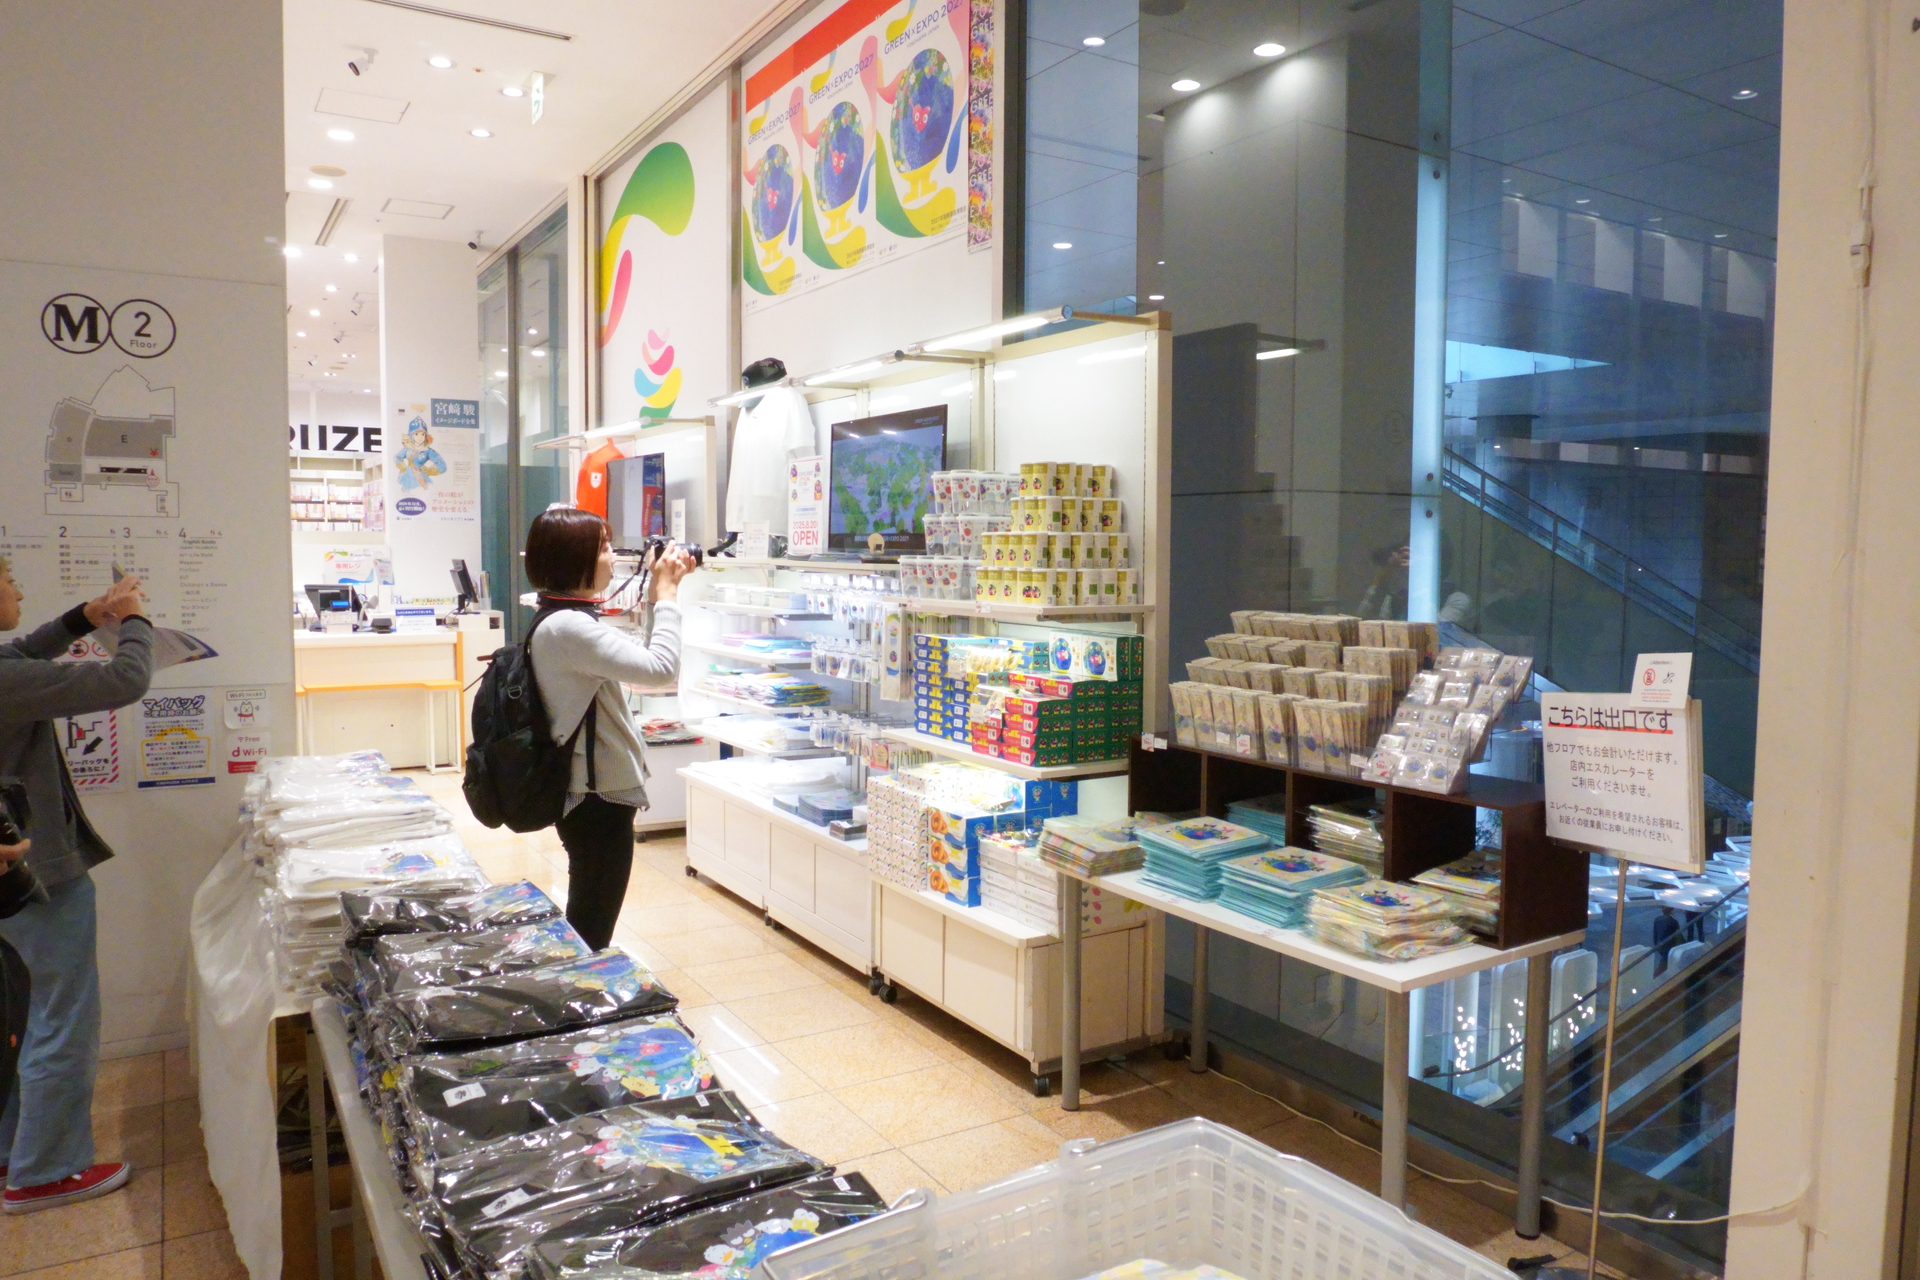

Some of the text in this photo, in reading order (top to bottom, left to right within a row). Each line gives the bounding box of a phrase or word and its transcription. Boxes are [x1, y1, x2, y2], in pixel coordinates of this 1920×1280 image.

[855, 53, 874, 75] 2027
[52, 303, 101, 344] M
[134, 311, 151, 338] 2
[130, 339, 157, 349] Floor
[121, 434, 128, 443] E
[1, 525, 6, 537] 1
[59, 526, 67, 538] 2
[123, 527, 131, 539] 3
[178, 527, 187, 539] 4
[793, 530, 819, 546] OPEN
[142, 694, 206, 711] マイバッグ
[1548, 706, 1673, 734] こちらは出口です
[1546, 741, 1678, 765] 他フロアでもお会計いただけます。
[1570, 760, 1655, 781] 店内エスカレーターを
[1572, 776, 1652, 798] ご利用くださいませ。
[1550, 801, 1684, 832] エレベーターのご利用を希望されるお客様は、
[1558, 815, 1674, 844] お近くの従業員にお申し付けください。
